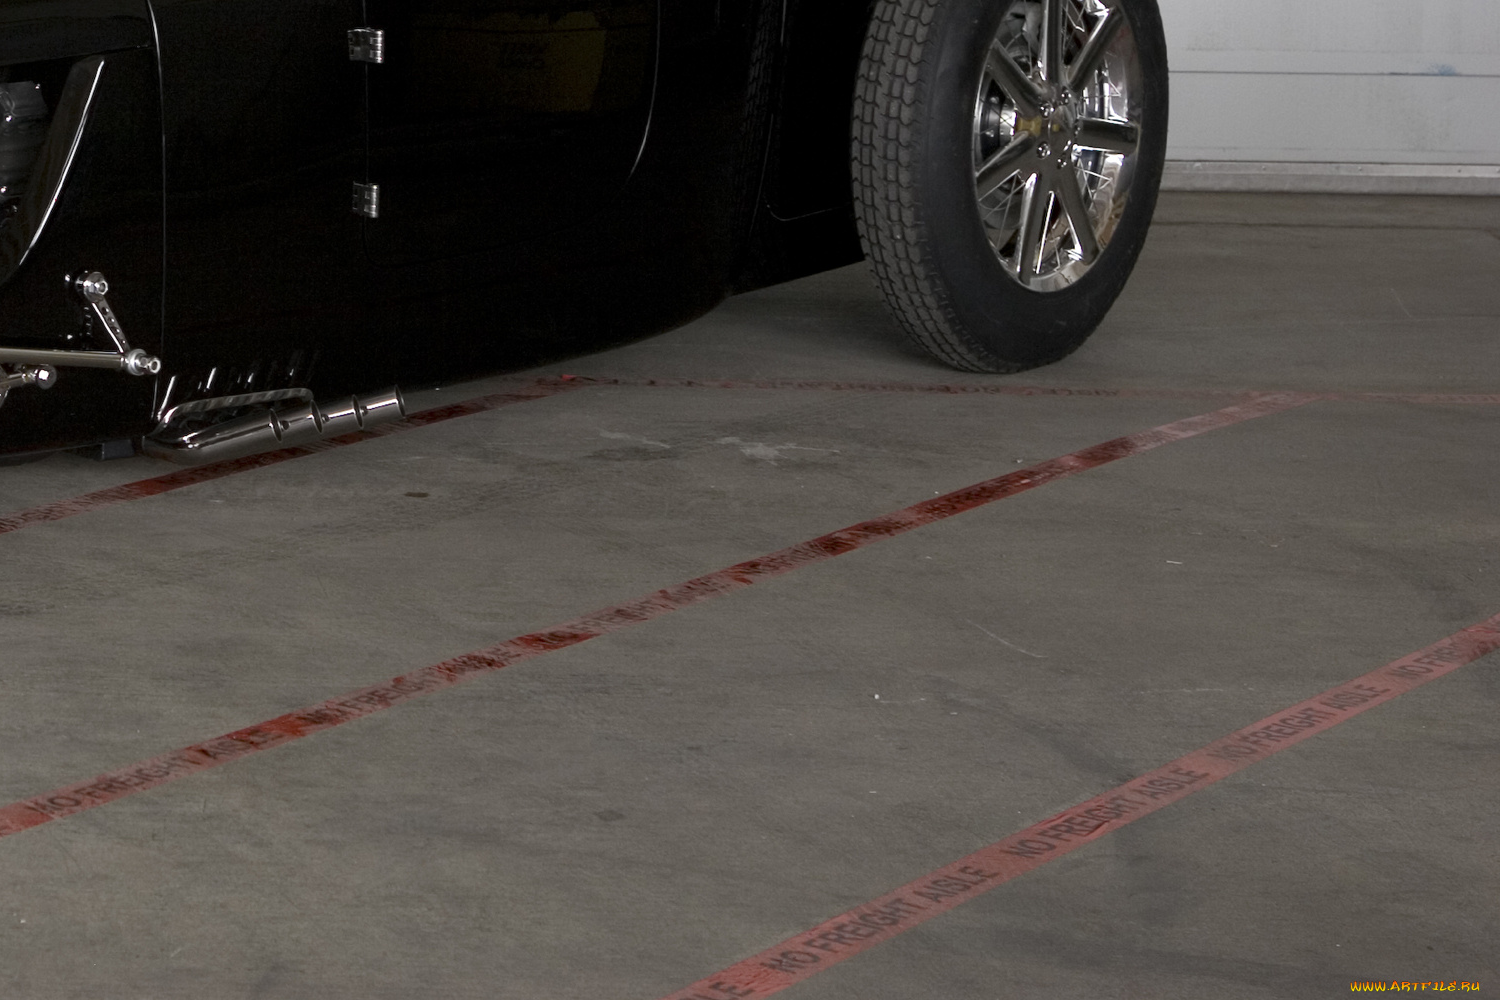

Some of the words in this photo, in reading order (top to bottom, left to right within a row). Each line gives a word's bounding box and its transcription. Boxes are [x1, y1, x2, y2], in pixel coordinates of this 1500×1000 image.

[760, 949, 821, 975] NO
[803, 898, 928, 954] FREIGHT
[913, 866, 1000, 904] AISLE
[1001, 839, 1057, 860] NO
[1050, 796, 1148, 842] FREIGHT
[1136, 767, 1209, 799] AISLE
[1320, 684, 1391, 711] AISLE
